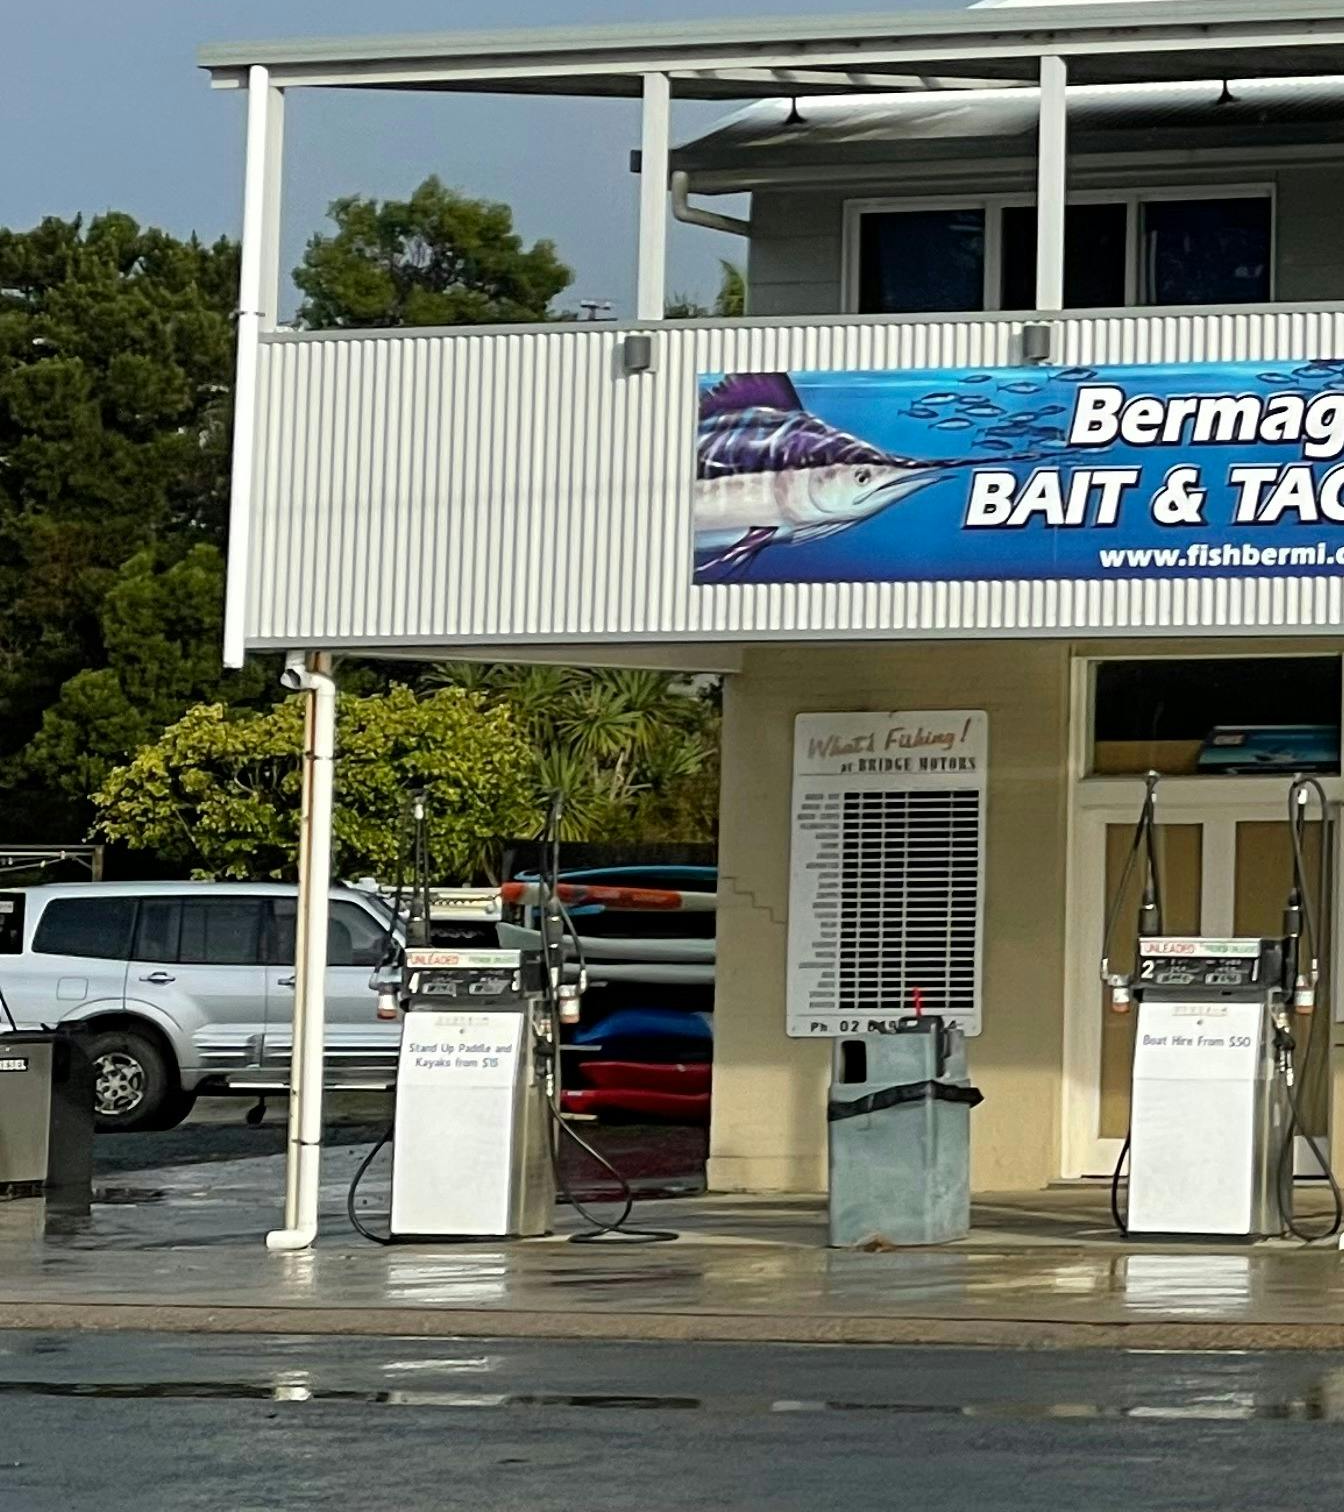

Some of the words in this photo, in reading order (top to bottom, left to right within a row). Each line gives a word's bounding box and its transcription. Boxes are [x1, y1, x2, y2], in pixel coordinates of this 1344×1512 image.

[964, 467, 1140, 526] BAIT
[1152, 464, 1207, 524] &
[858, 757, 911, 772] BRIDGE
[919, 756, 976, 771] MOTORS
[1141, 959, 1155, 979] 2
[839, 1020, 860, 1032] 02
[1142, 1034, 1167, 1046] Boat
[1171, 1035, 1193, 1046] Hire
[1197, 1035, 1224, 1046] From
[1228, 1036, 1251, 1047] $50
[409, 1043, 438, 1053] Stand
[441, 1043, 454, 1054] Up
[458, 1043, 491, 1053] Paddle
[495, 1044, 513, 1053] and
[415, 1057, 451, 1068] Kayaks
[455, 1057, 478, 1067] from
